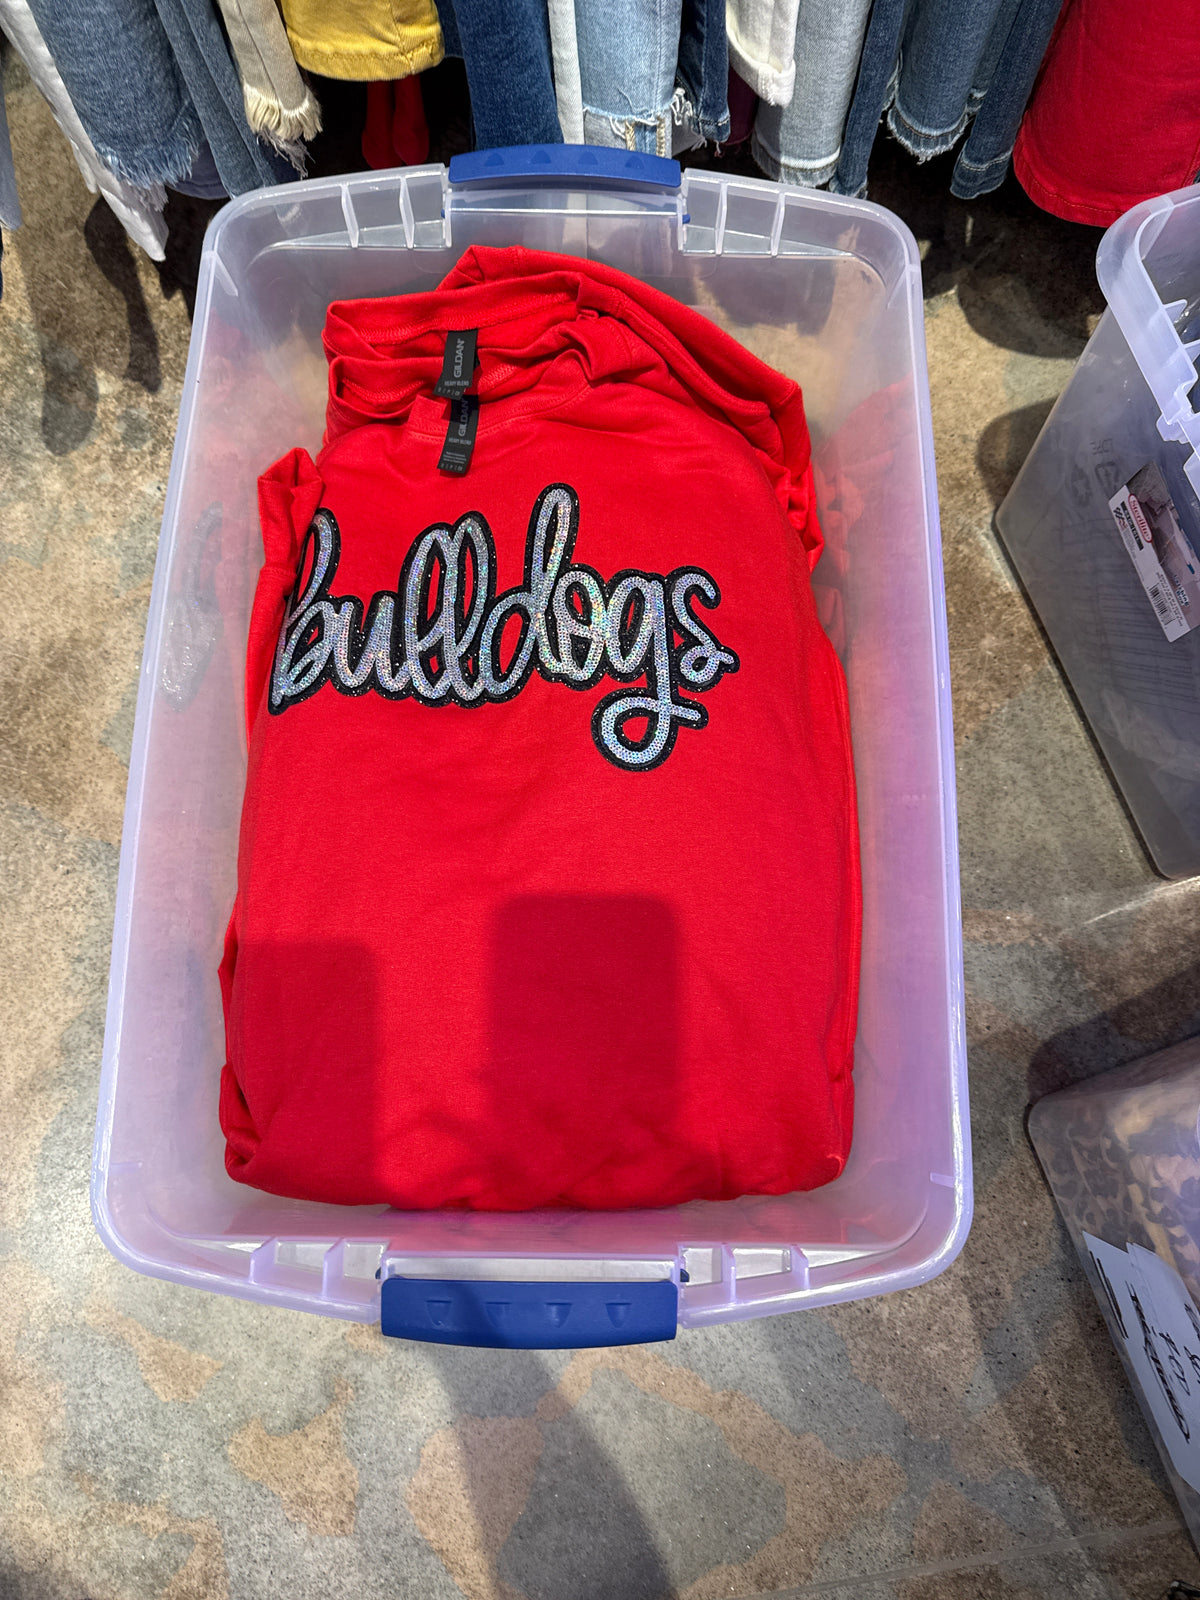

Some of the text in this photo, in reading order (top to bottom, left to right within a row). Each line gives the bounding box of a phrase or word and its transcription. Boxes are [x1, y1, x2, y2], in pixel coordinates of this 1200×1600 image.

[453, 338, 465, 378] GILDAN
[458, 397, 469, 437] GILDAN
[1130, 499, 1151, 541] Sterilite
[268, 483, 740, 772] bulldogs
